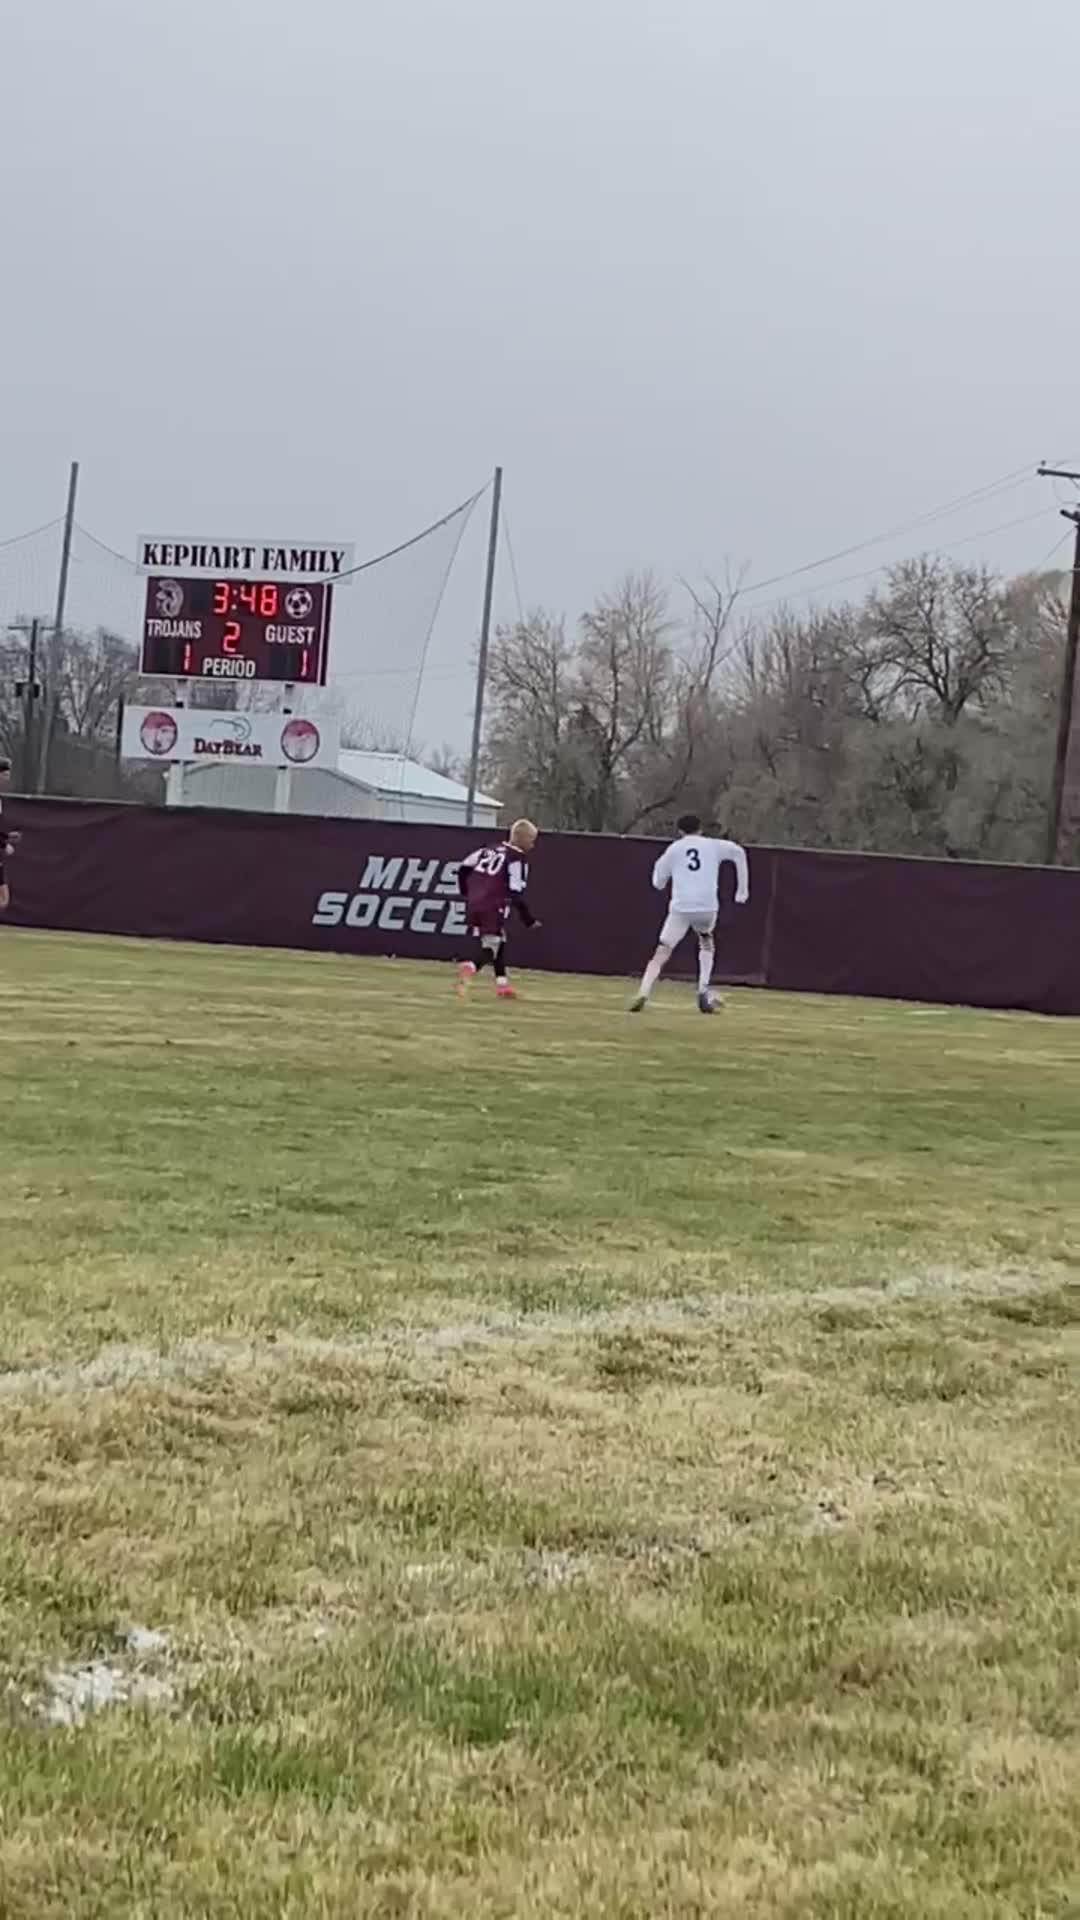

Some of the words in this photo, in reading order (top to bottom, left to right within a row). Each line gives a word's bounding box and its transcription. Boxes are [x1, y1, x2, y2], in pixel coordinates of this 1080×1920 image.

[143, 543, 256, 570] KEPHART
[262, 549, 345, 573] FAMILY
[214, 583, 277, 616] 3:48
[147, 619, 202, 638] TROJANS
[223, 622, 240, 652] 2
[265, 625, 315, 645] GUEST
[184, 644, 191, 671] 1
[203, 657, 256, 678] PERIOD
[301, 650, 307, 676] 1
[476, 850, 505, 876] 20
[686, 848, 701, 871] 3
[360, 856, 462, 894] MHS
[312, 892, 468, 935] SOCCE
